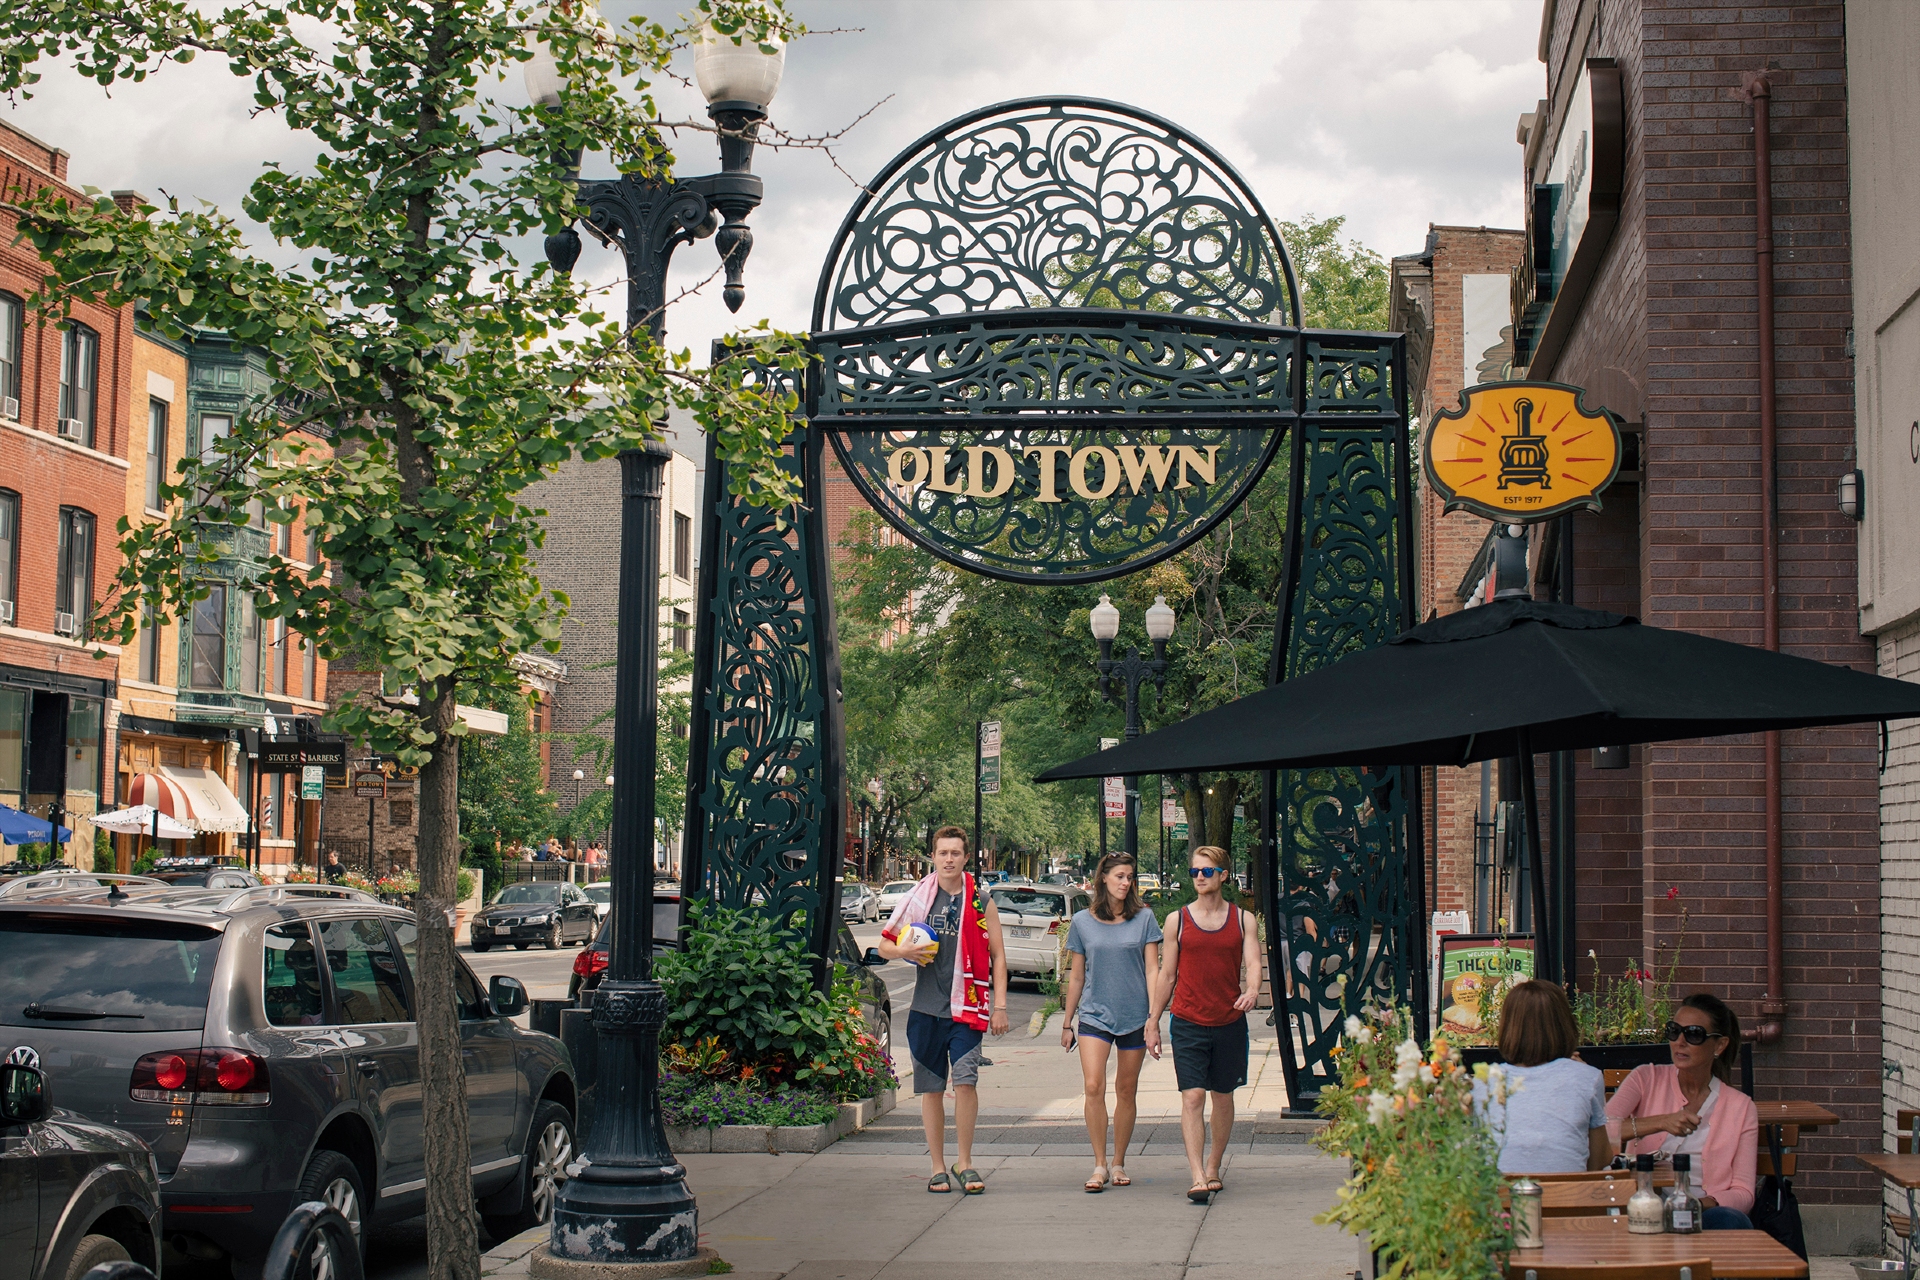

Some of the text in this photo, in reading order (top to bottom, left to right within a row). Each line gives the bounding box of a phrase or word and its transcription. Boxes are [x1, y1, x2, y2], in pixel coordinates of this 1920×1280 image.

[887, 444, 1221, 502] OLD TOWN
[1524, 496, 1543, 504] 1977
[268, 753, 289, 762] STATE
[307, 754, 339, 762] BARBERS
[1487, 958, 1522, 972] CUB
